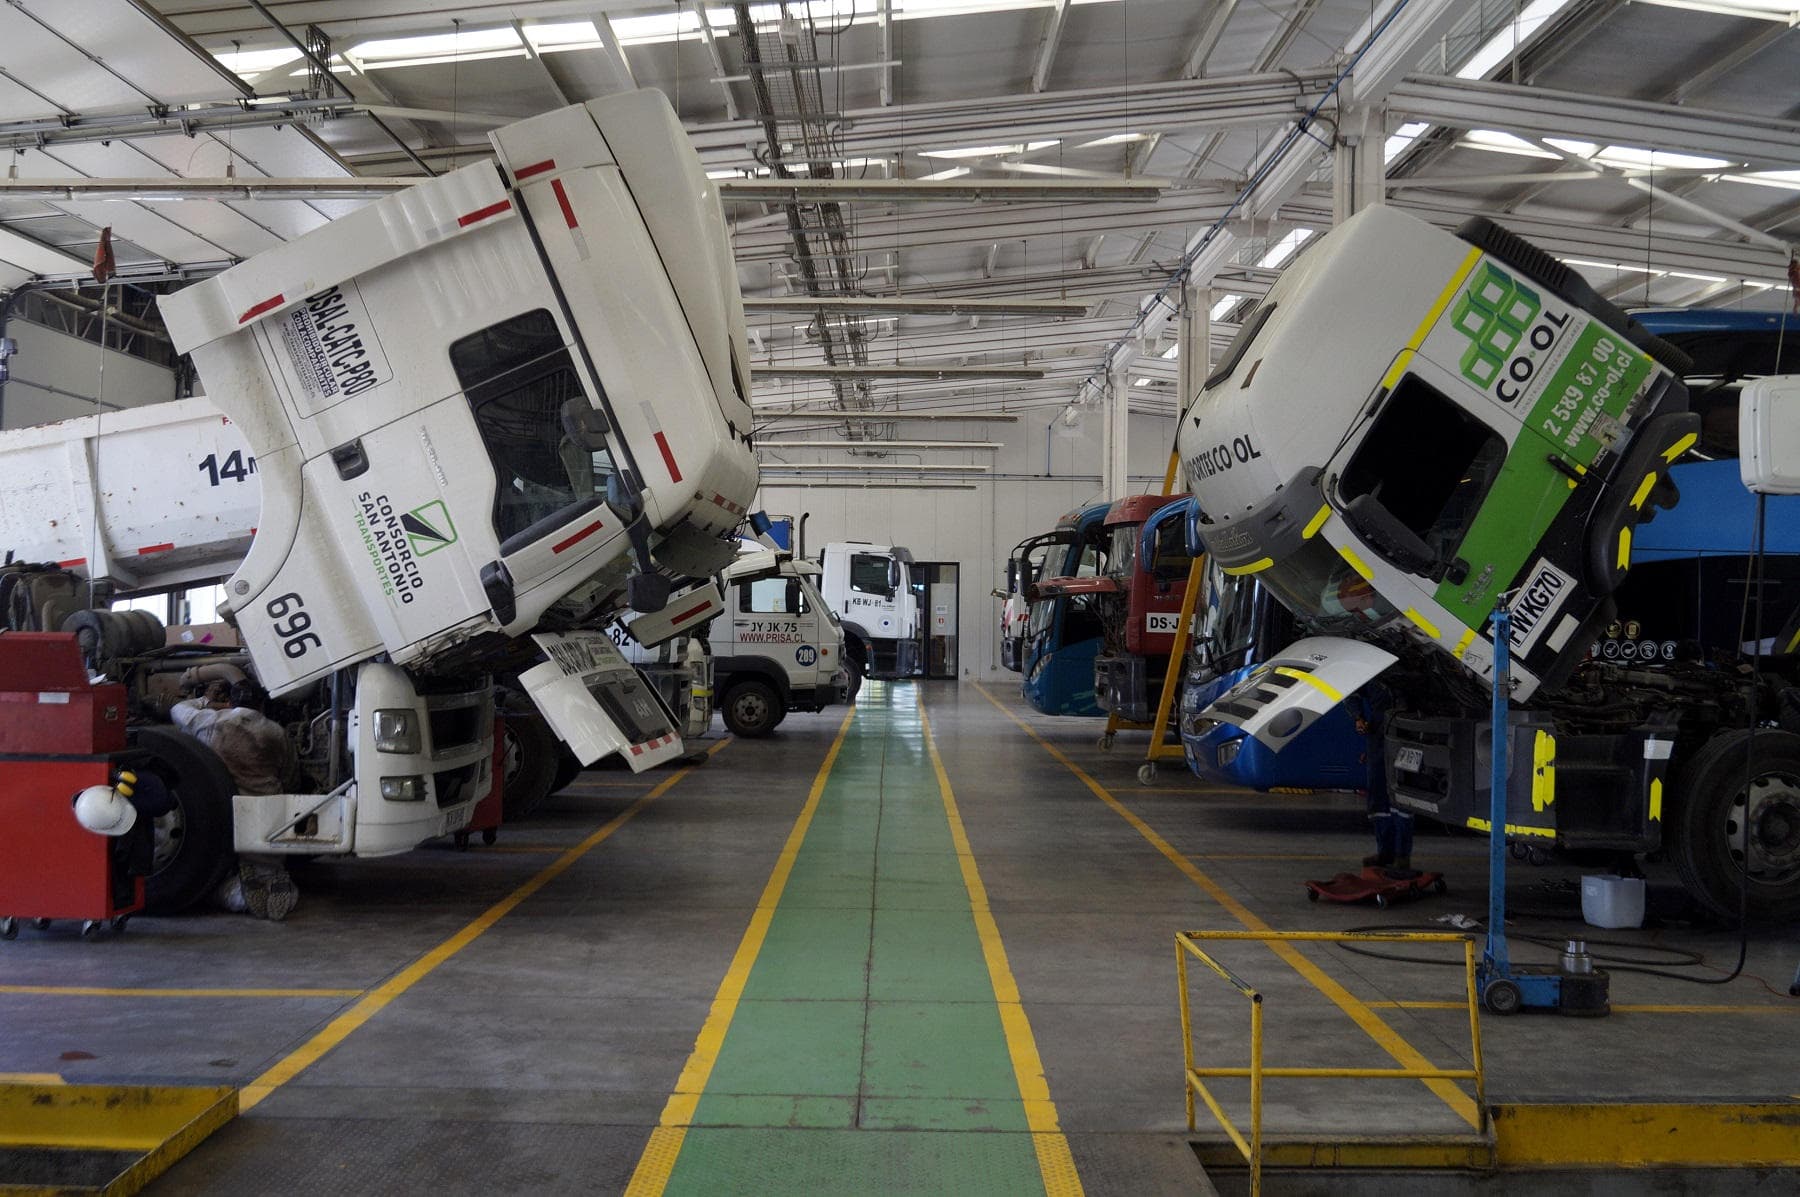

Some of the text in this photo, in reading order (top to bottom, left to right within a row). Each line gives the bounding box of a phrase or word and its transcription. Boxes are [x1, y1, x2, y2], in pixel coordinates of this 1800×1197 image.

[292, 311, 304, 330] CON
[299, 330, 331, 396] ACOMPAÑANTES
[298, 308, 321, 352] PROHIBIDO
[317, 352, 338, 393] CIRCULAR
[1543, 337, 1615, 436] 2 589 87 00
[1563, 352, 1633, 446] www.co-ol.cl
[354, 511, 393, 596] TRANSPORTES
[358, 491, 413, 604] SAN ANTONIO
[376, 495, 423, 588] CONSORCIO
[266, 592, 322, 658] 696
[740, 633, 806, 643] WWW.PRISA.CL
[751, 622, 798, 632] JY JK 75
[798, 648, 814, 663] 289
